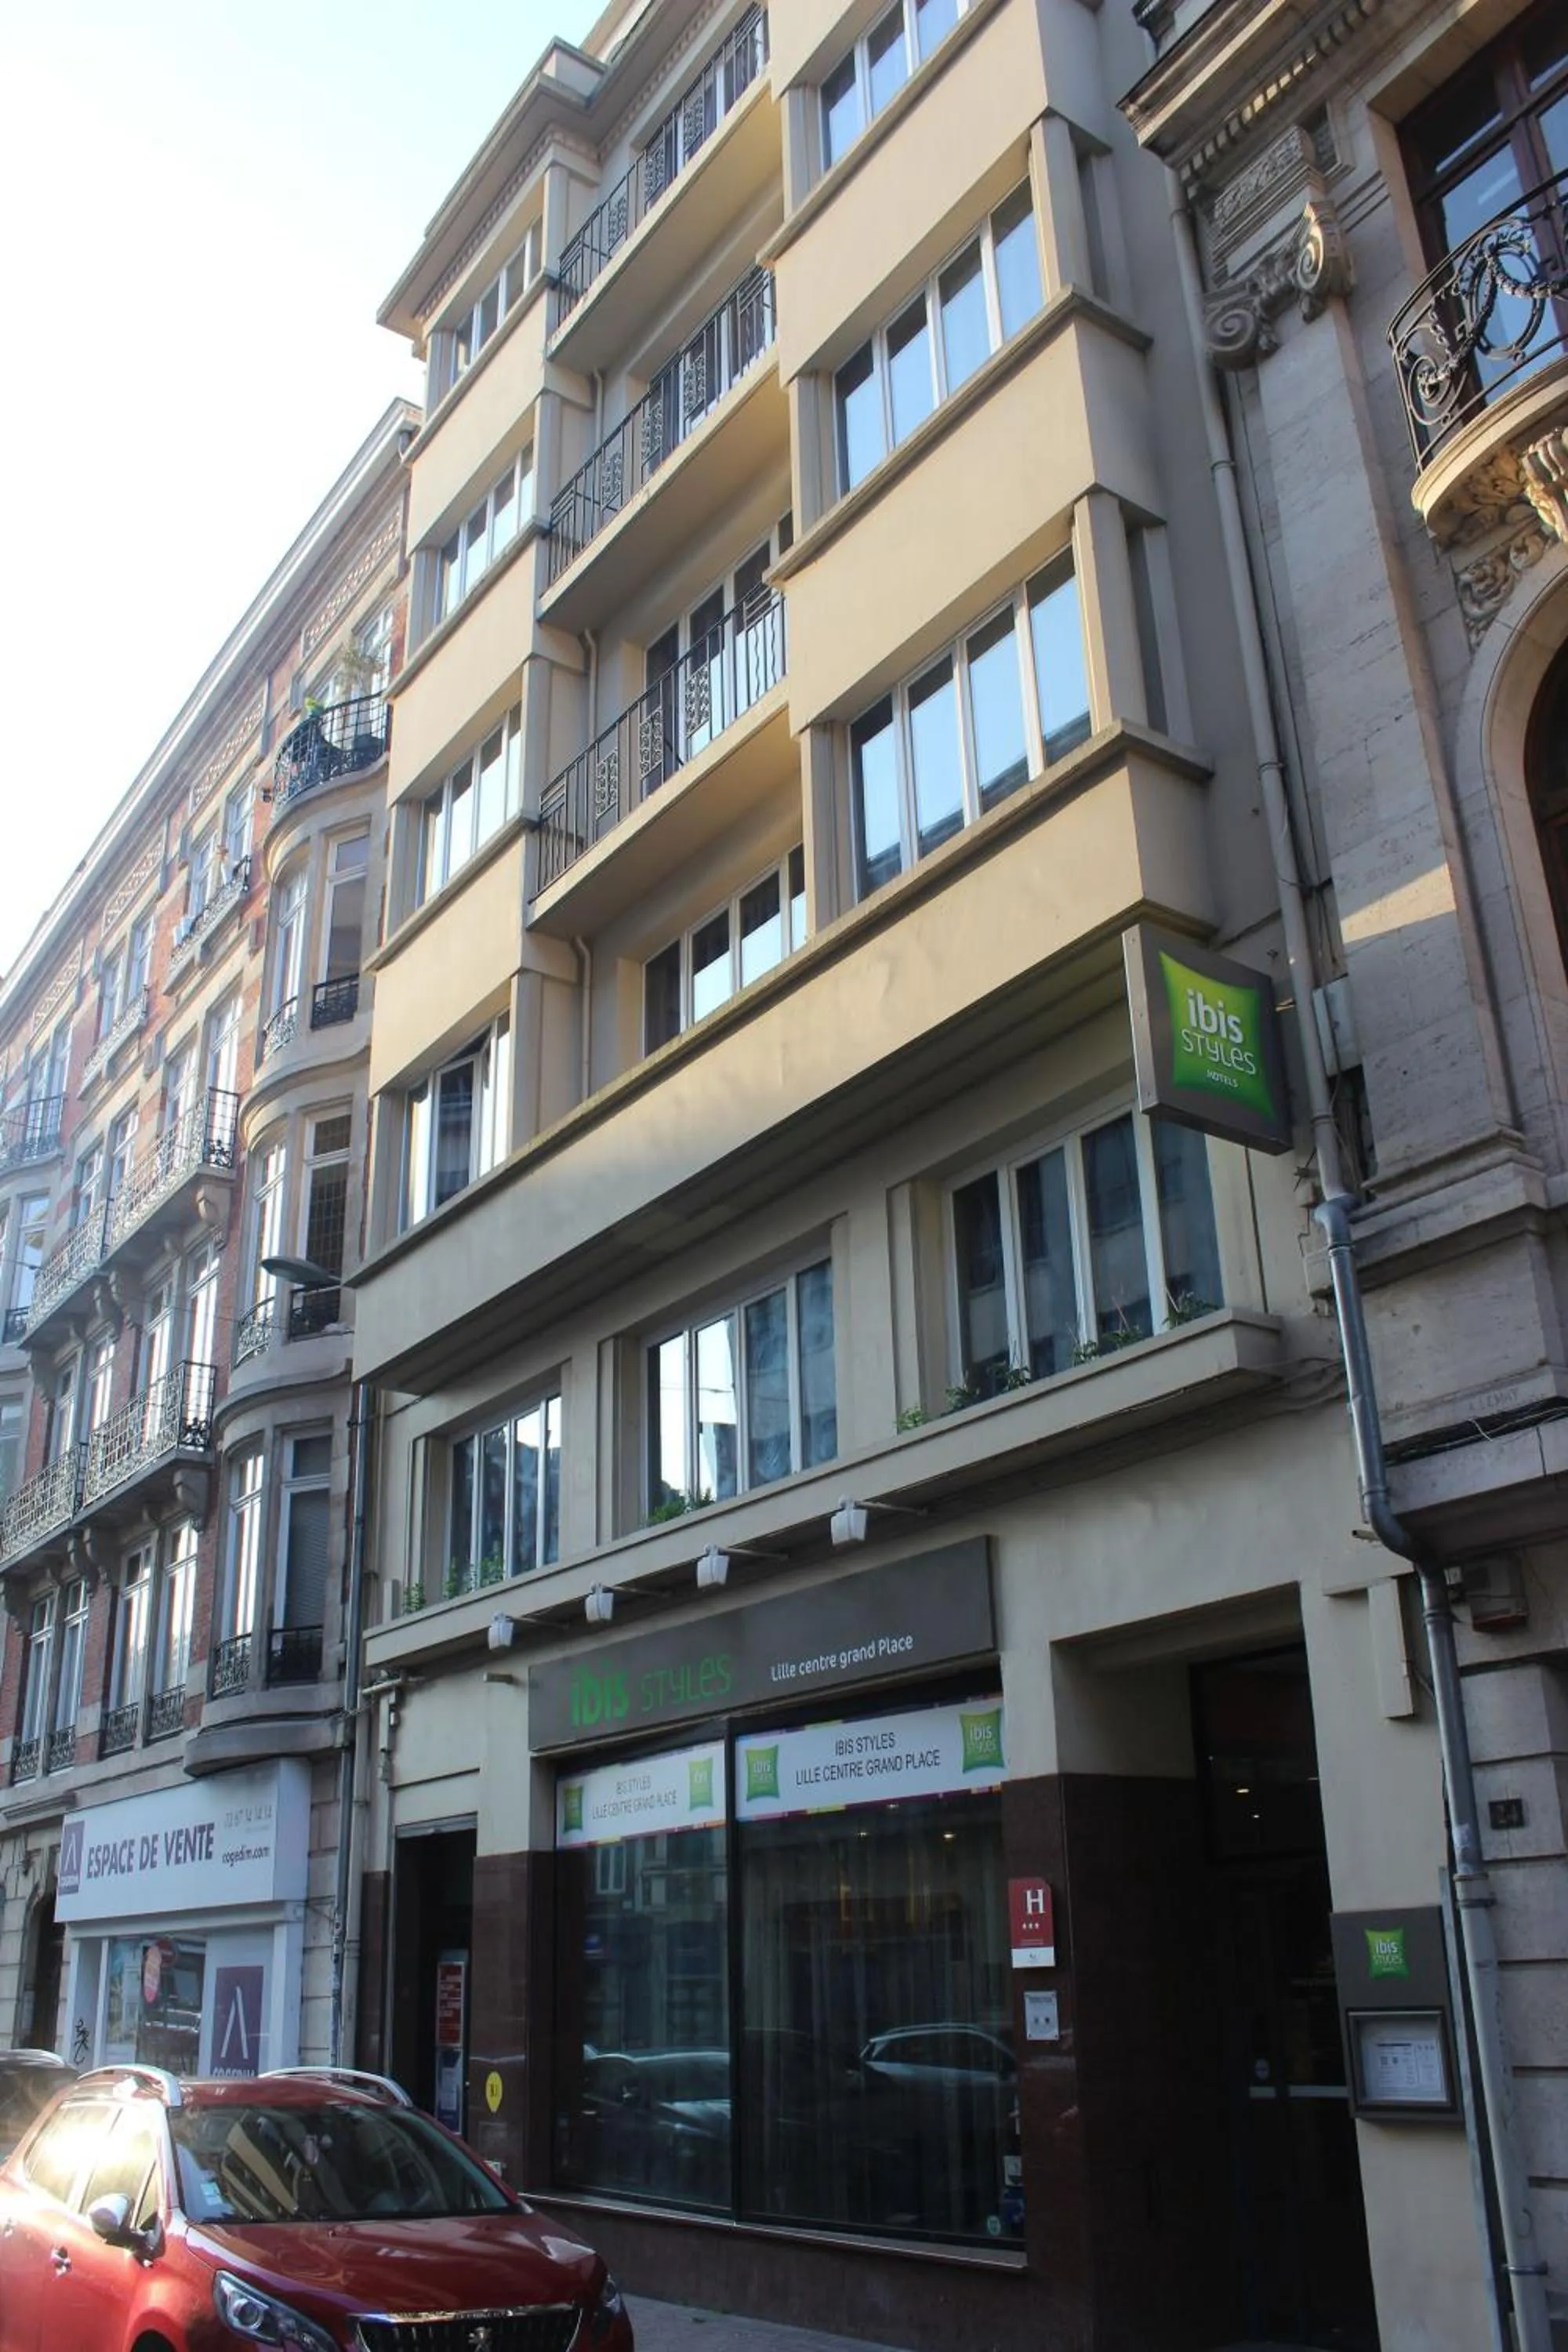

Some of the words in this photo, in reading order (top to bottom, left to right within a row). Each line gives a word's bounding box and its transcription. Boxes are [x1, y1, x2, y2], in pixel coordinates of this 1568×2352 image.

[1186, 988, 1244, 1044] ibis
[771, 1663, 797, 1682] Lille
[799, 1654, 837, 1675] centre
[840, 1641, 876, 1669] grand
[878, 1635, 913, 1657] Place
[571, 1658, 630, 1728] ibis
[796, 1766, 821, 1785] LILLE
[822, 1761, 863, 1781] CENTRE
[866, 1755, 902, 1777] GRAND
[906, 1749, 941, 1770] PLACE
[835, 1738, 854, 1756] IBIS
[855, 1732, 895, 1753] STYLES
[87, 1838, 135, 1879] ESPACE
[139, 1833, 159, 1871] DE
[164, 1822, 216, 1866] VENTE
[1026, 1889, 1045, 1915] H
